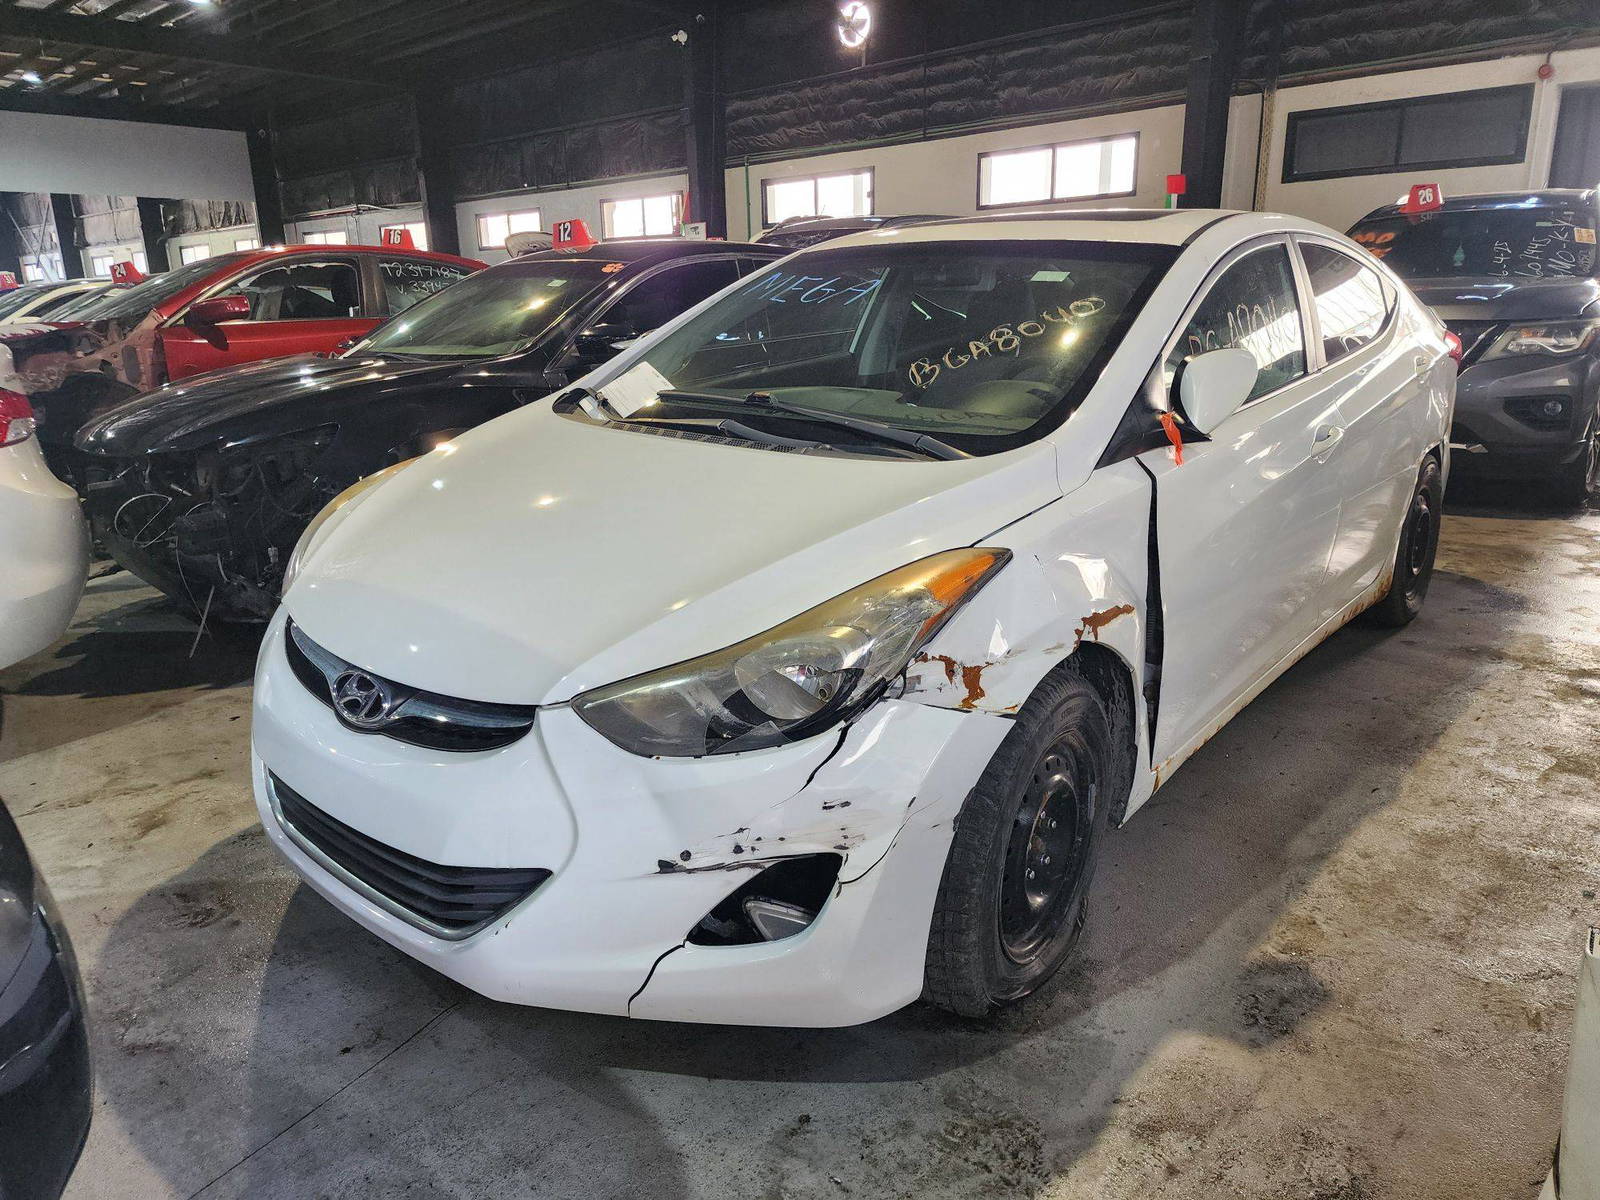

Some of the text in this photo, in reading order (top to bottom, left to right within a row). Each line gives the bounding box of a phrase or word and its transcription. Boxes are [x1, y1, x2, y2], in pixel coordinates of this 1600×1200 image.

[1418, 187, 1433, 205] 26
[389, 229, 402, 245] 16
[559, 221, 572, 242] 12
[113, 264, 127, 278] 24
[909, 297, 1106, 389] BGA8040
